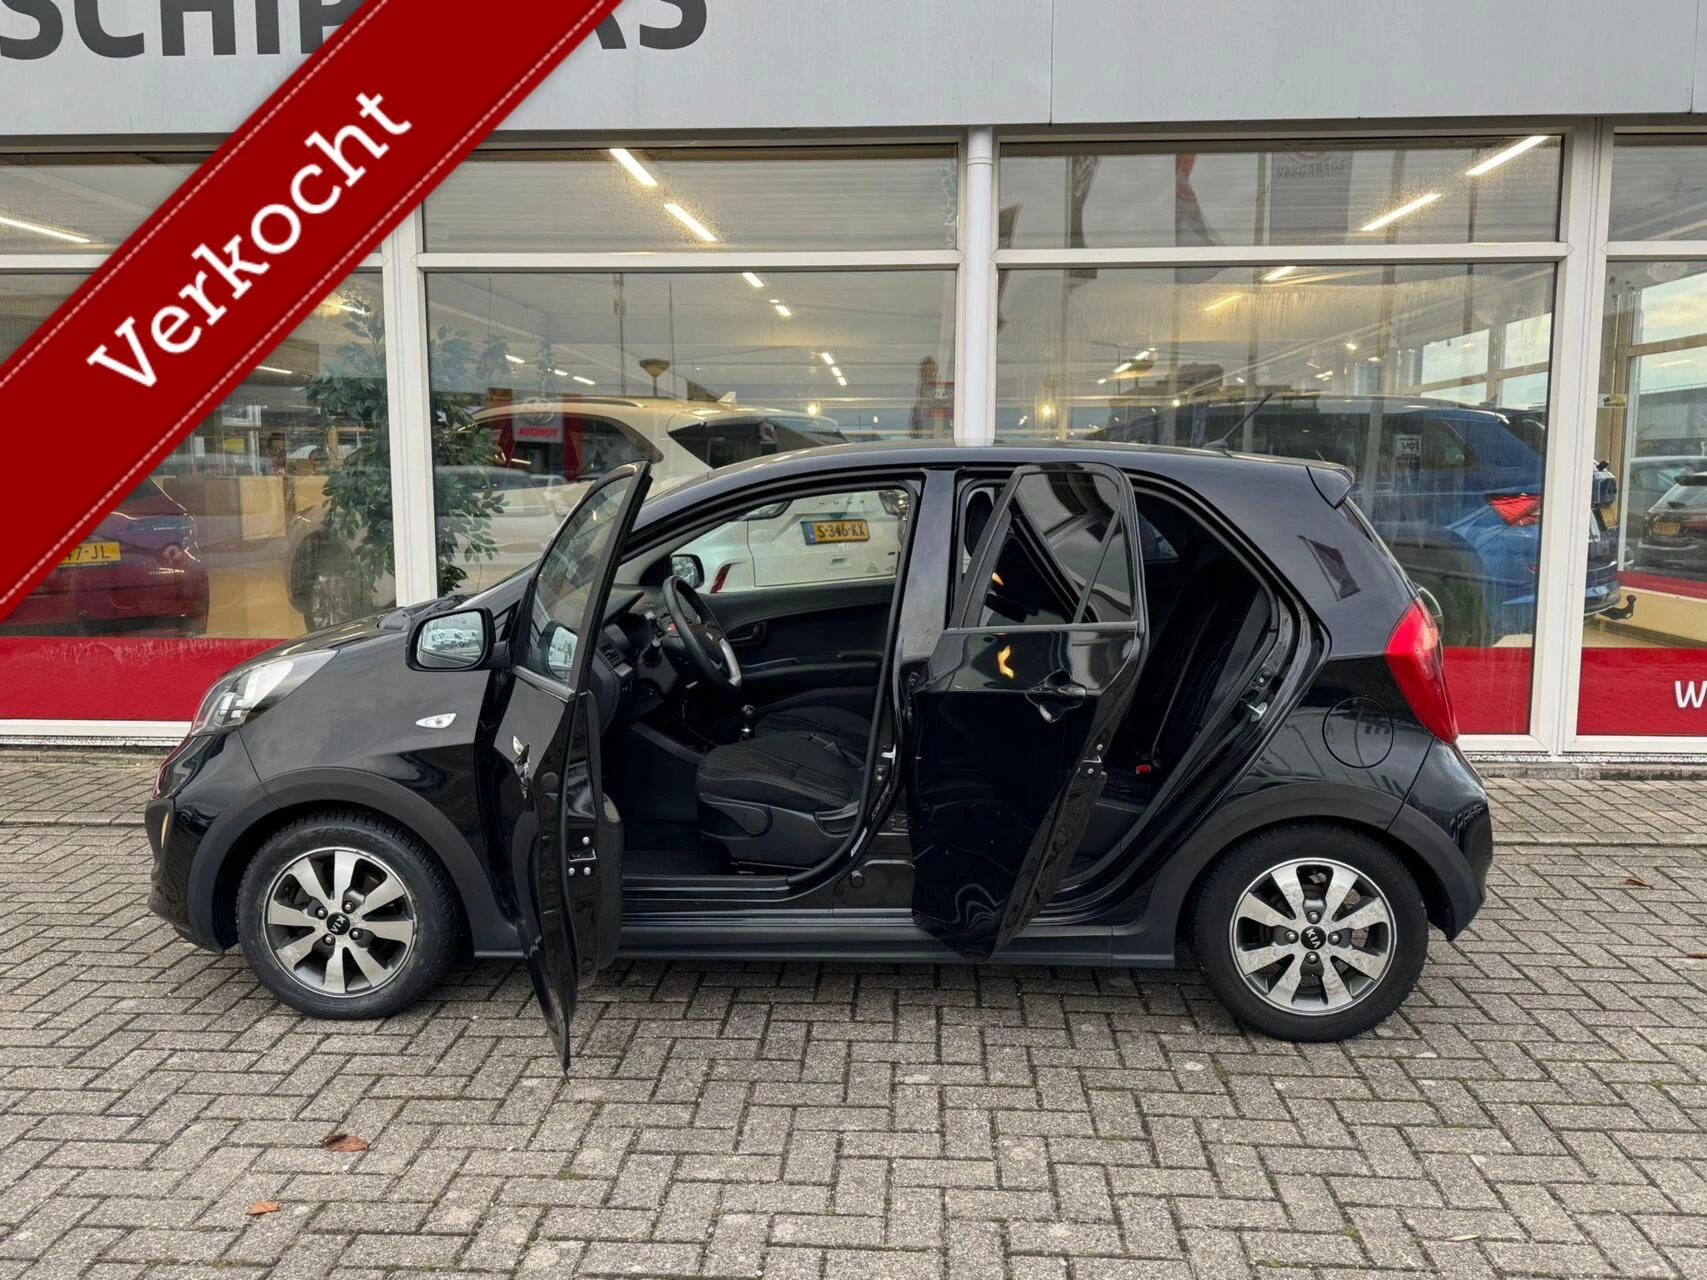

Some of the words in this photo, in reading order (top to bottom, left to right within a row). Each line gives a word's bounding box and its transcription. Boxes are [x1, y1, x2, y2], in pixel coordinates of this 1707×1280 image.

[816, 522, 866, 539] S-346-KX
[330, 915, 346, 934] KIA
[1305, 928, 1322, 949] KIA
